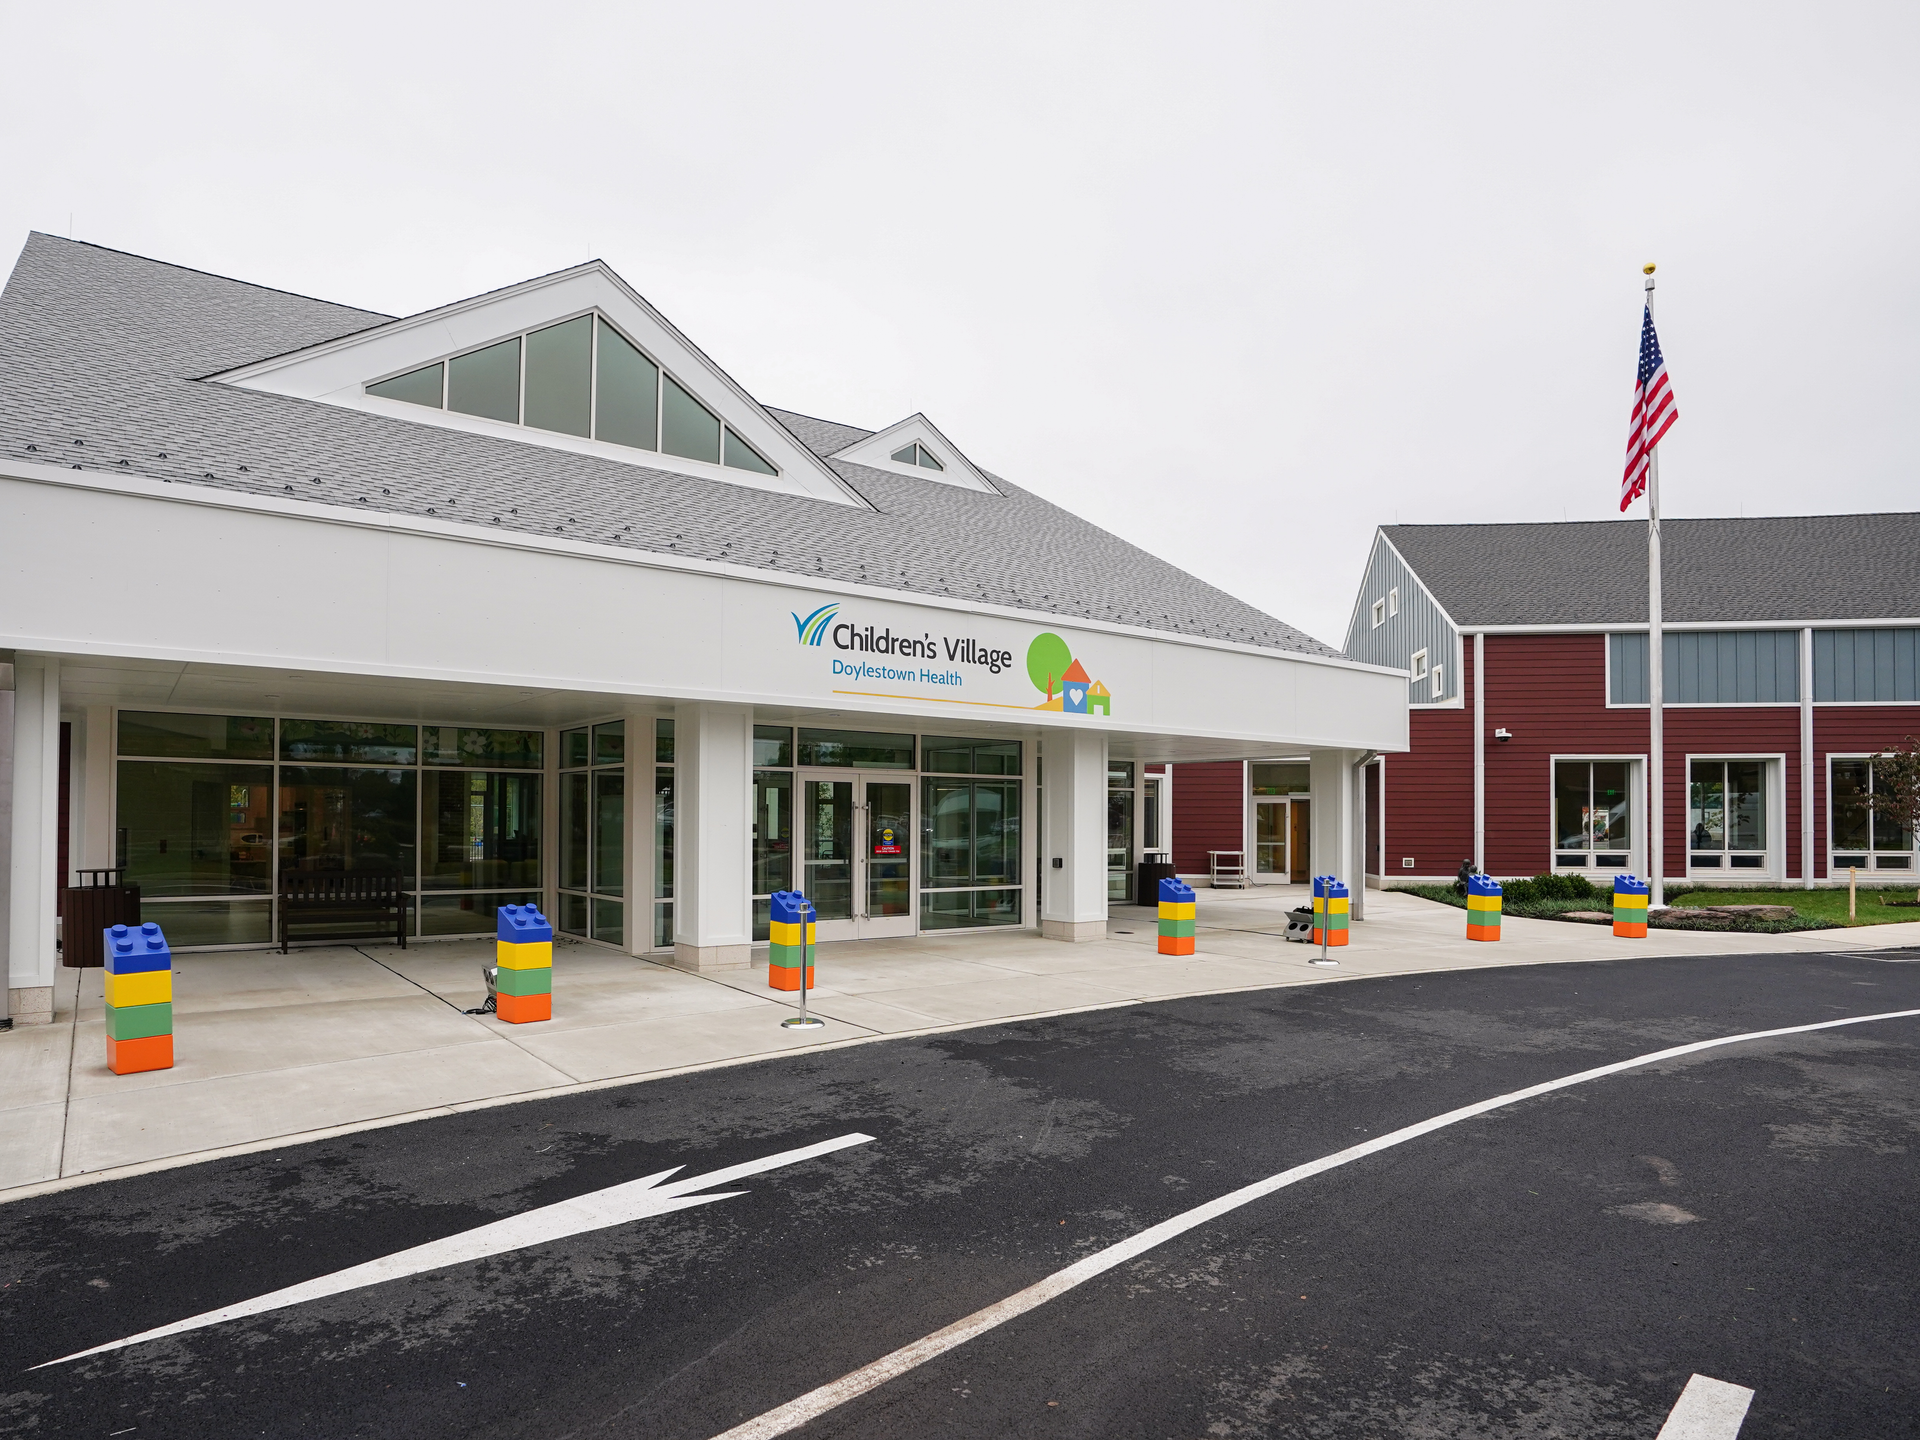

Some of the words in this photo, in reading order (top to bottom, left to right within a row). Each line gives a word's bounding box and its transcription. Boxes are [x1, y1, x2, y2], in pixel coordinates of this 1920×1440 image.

[833, 624, 937, 659] Children's
[943, 636, 1012, 674] Village
[832, 660, 915, 681] Doylestown
[919, 668, 962, 686] Health
